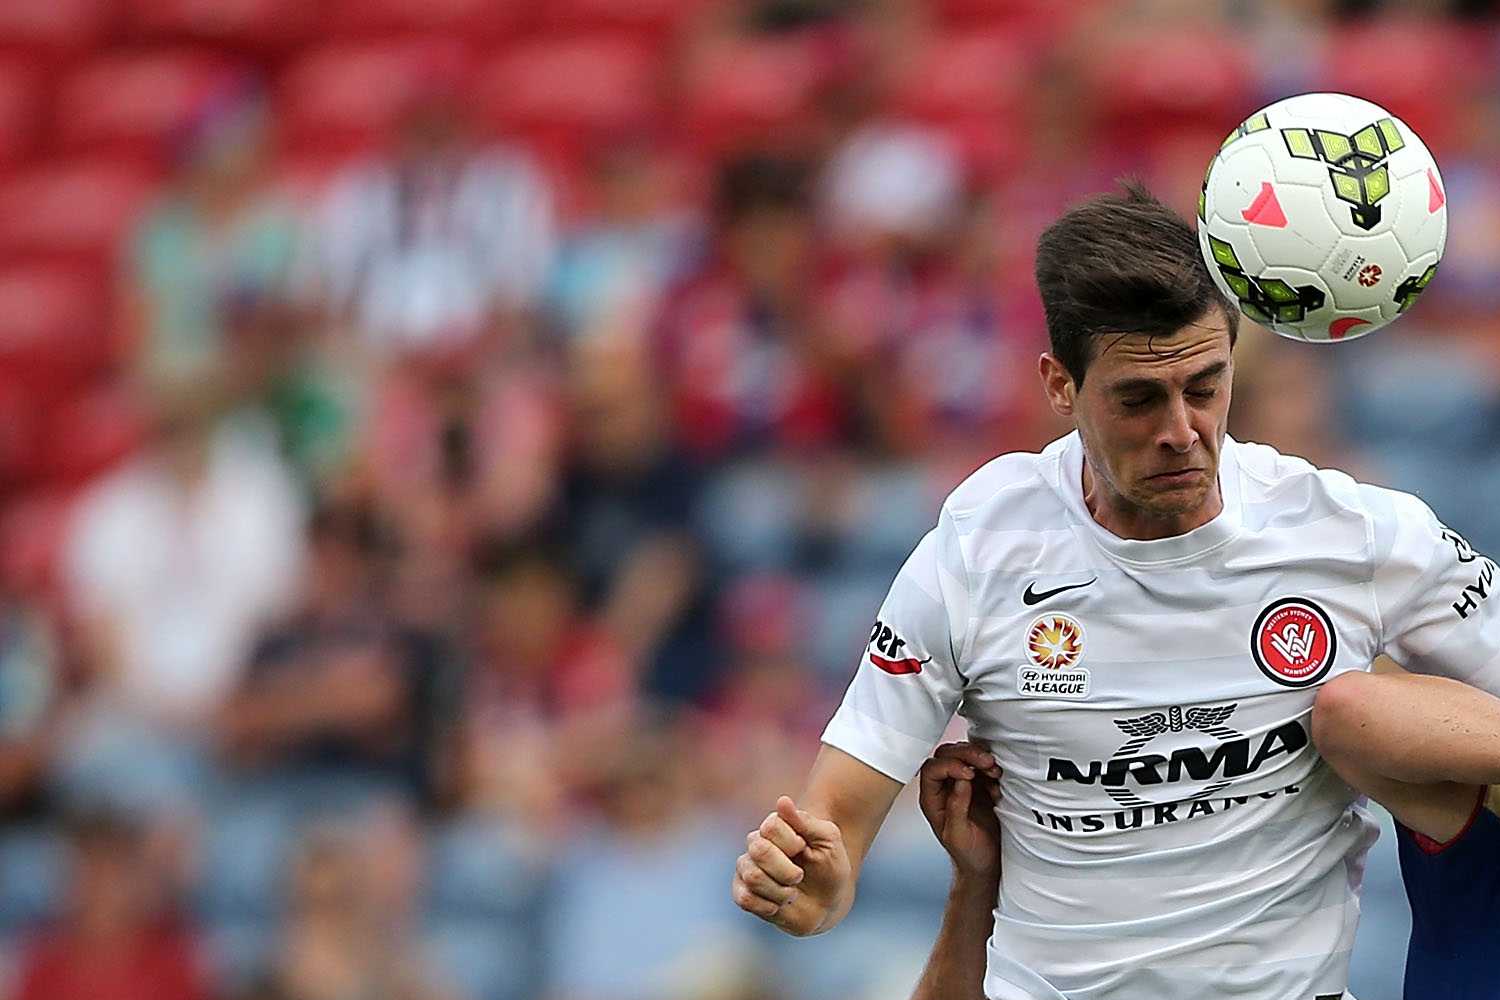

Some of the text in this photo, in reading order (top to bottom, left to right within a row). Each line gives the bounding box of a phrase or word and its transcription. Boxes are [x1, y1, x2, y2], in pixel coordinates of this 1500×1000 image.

[1452, 560, 1495, 619] HYU
[1022, 681, 1085, 694] A-LEAGUE
[1041, 673, 1086, 682] HYUNDAI
[1046, 719, 1309, 787] NRMA
